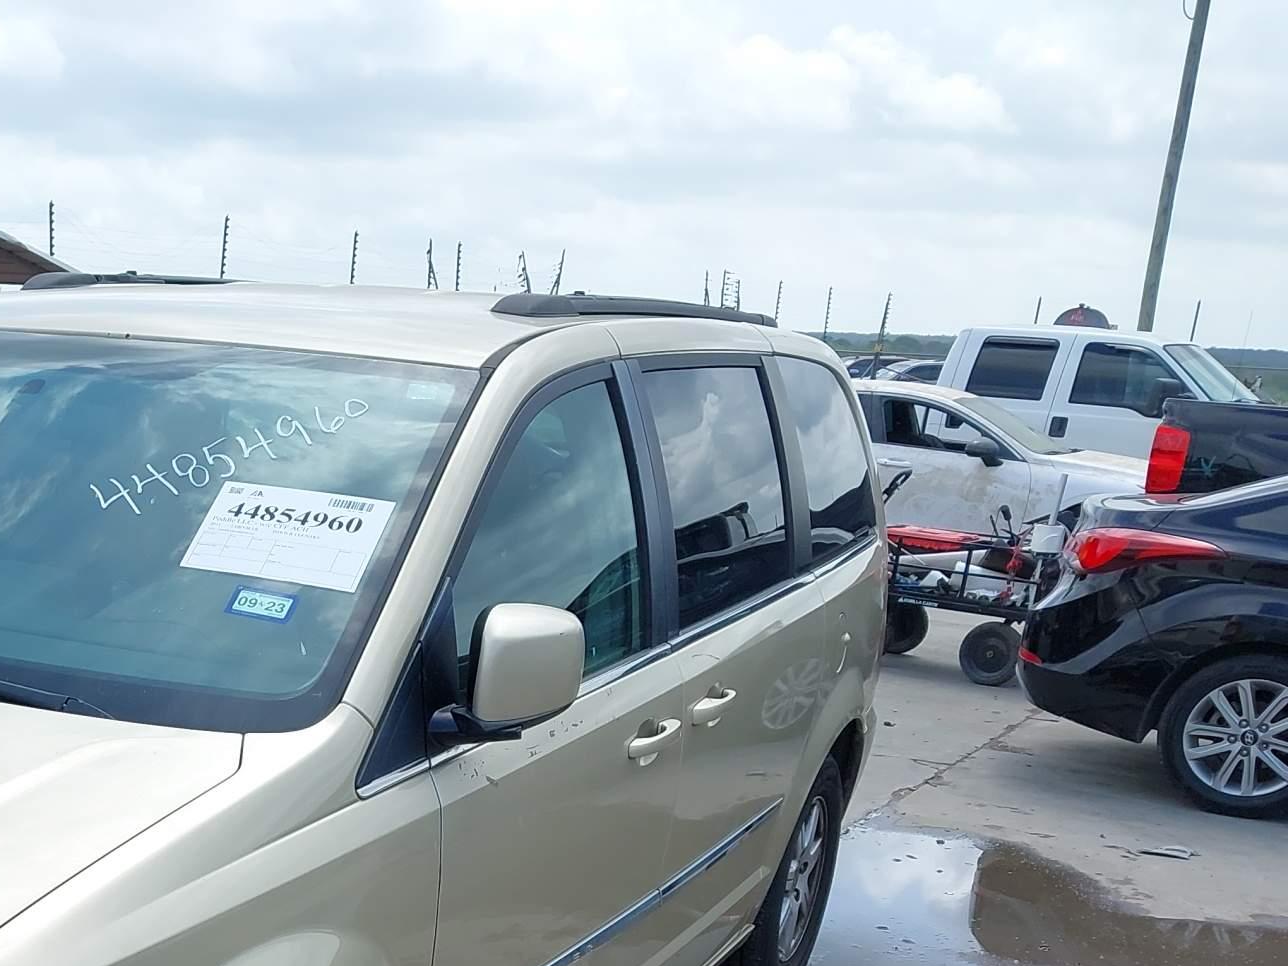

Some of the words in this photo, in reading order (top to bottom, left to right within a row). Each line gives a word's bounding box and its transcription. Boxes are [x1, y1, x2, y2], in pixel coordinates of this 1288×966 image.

[89, 398, 369, 515] 44854960
[227, 502, 363, 533] 44854960
[237, 596, 259, 609] 09
[264, 601, 287, 614] 23
